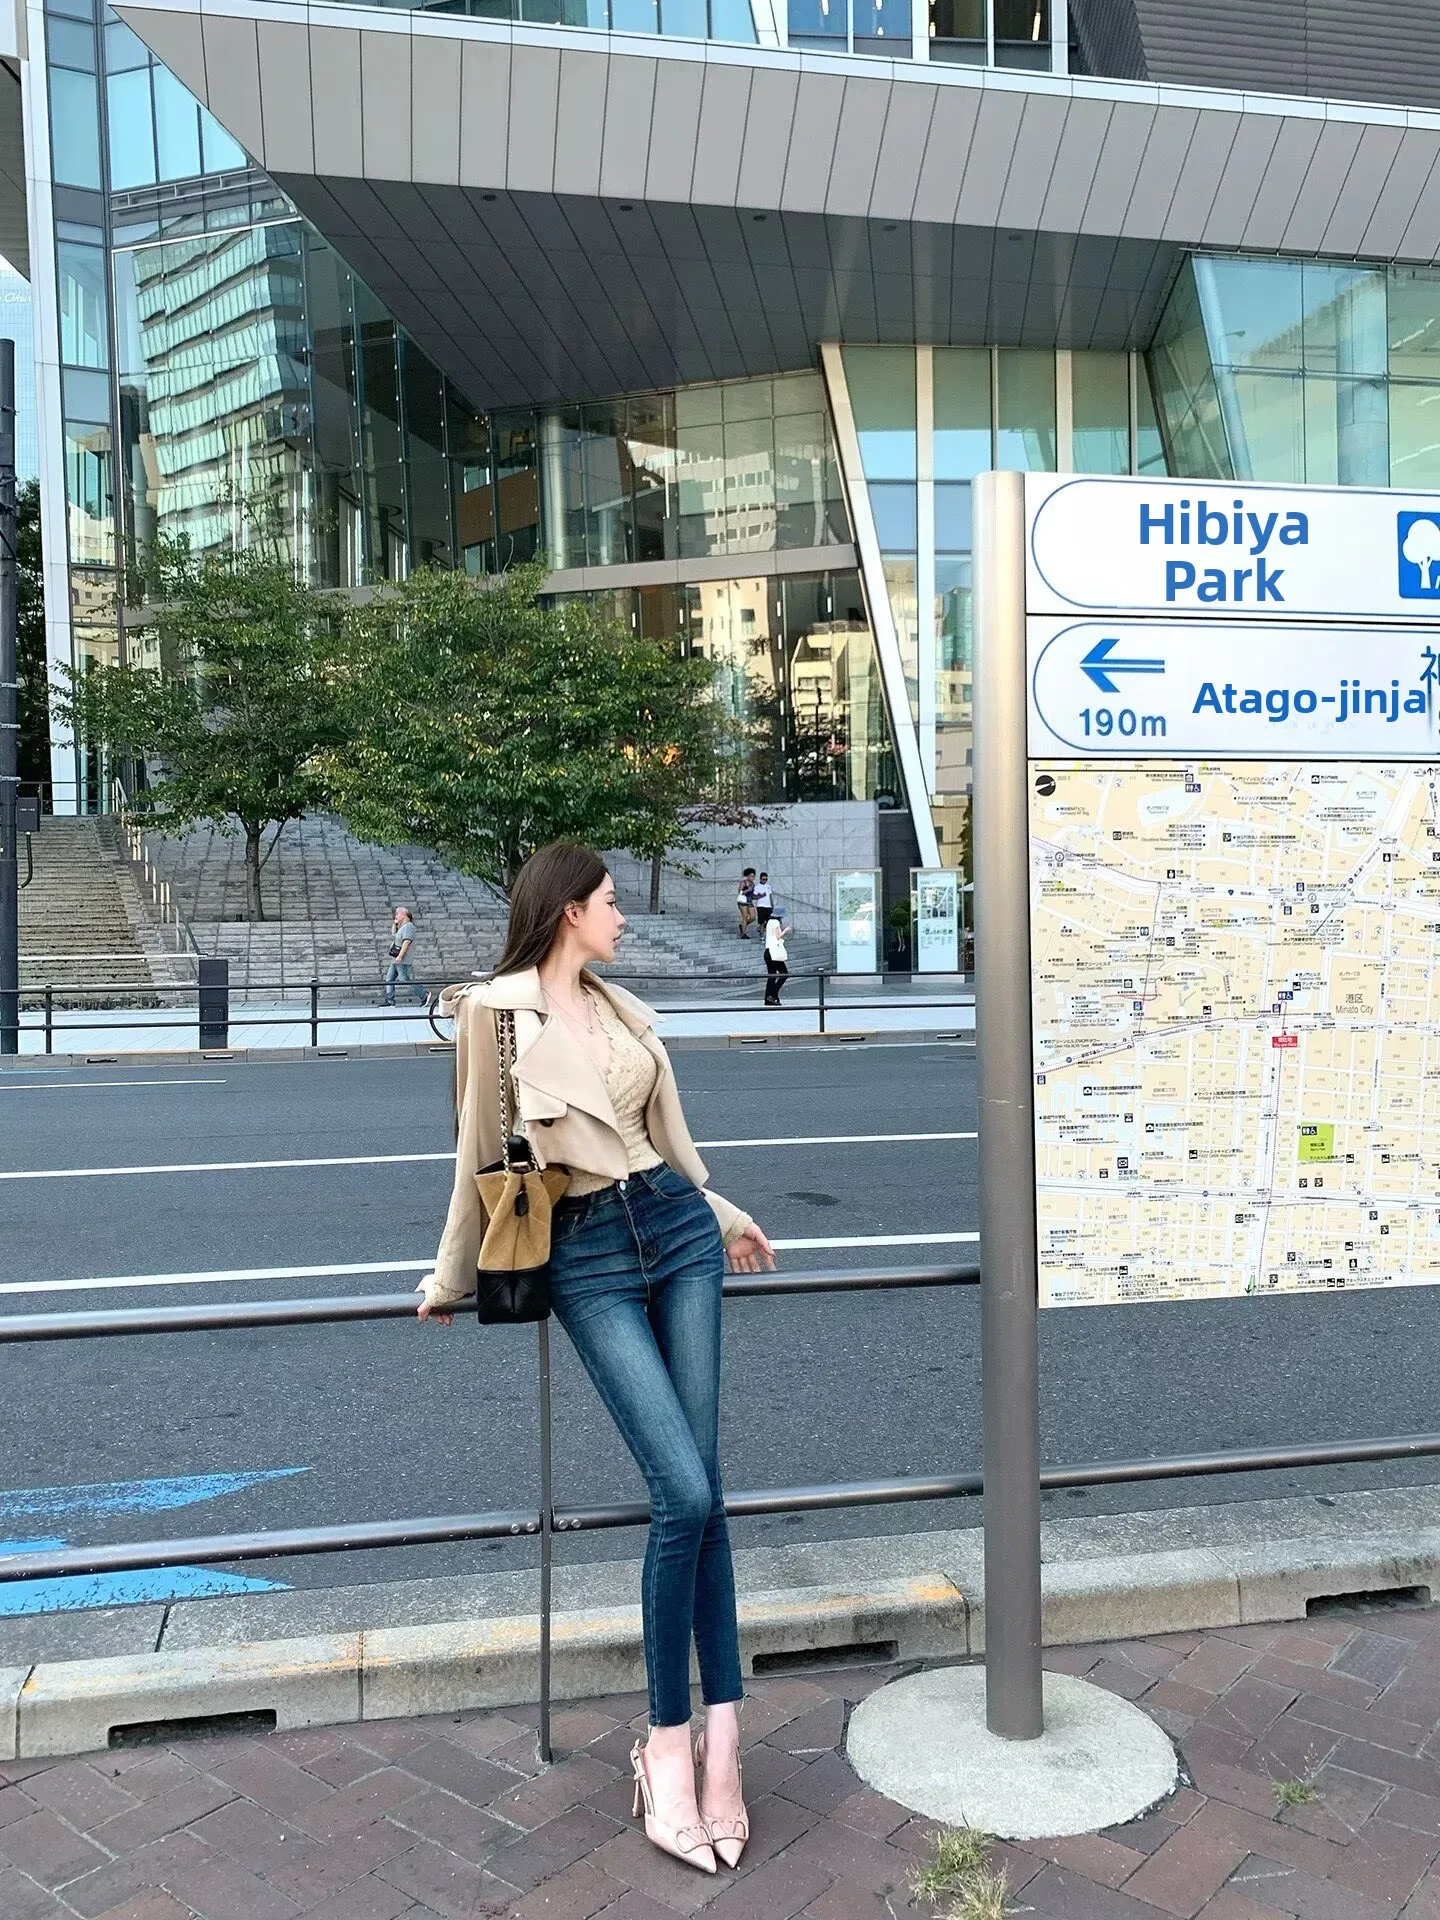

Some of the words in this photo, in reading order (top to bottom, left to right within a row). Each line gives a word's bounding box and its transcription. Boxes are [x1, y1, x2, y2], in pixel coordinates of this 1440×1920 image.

[1140, 499, 1309, 555] Hibiya
[1165, 558, 1285, 602] Park
[1192, 679, 1426, 722] Atago-jinja
[1079, 708, 1167, 737] 190m
[1335, 1005, 1359, 1014] Minato
[1360, 1005, 1374, 1015] City
[1345, 993, 1364, 1004] 港区
